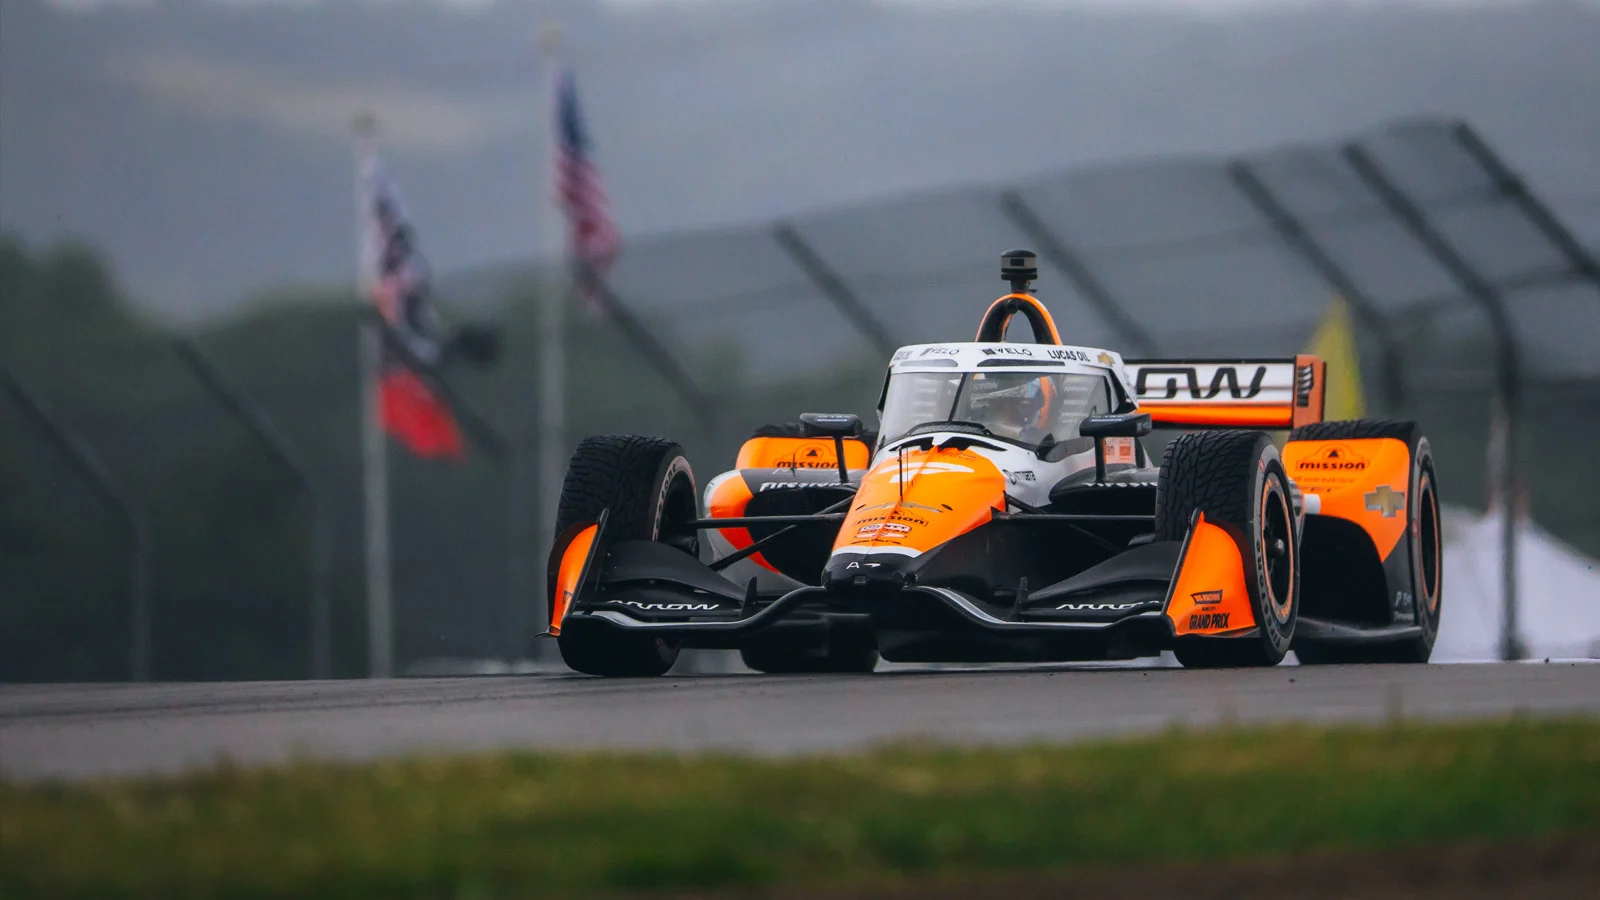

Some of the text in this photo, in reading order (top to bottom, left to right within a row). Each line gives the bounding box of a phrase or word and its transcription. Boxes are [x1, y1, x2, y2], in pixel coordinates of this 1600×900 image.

[1047, 350, 1091, 362] LUCAS OIL
[1299, 462, 1365, 470] mission
[1189, 612, 1231, 630] GRAND PRIX
